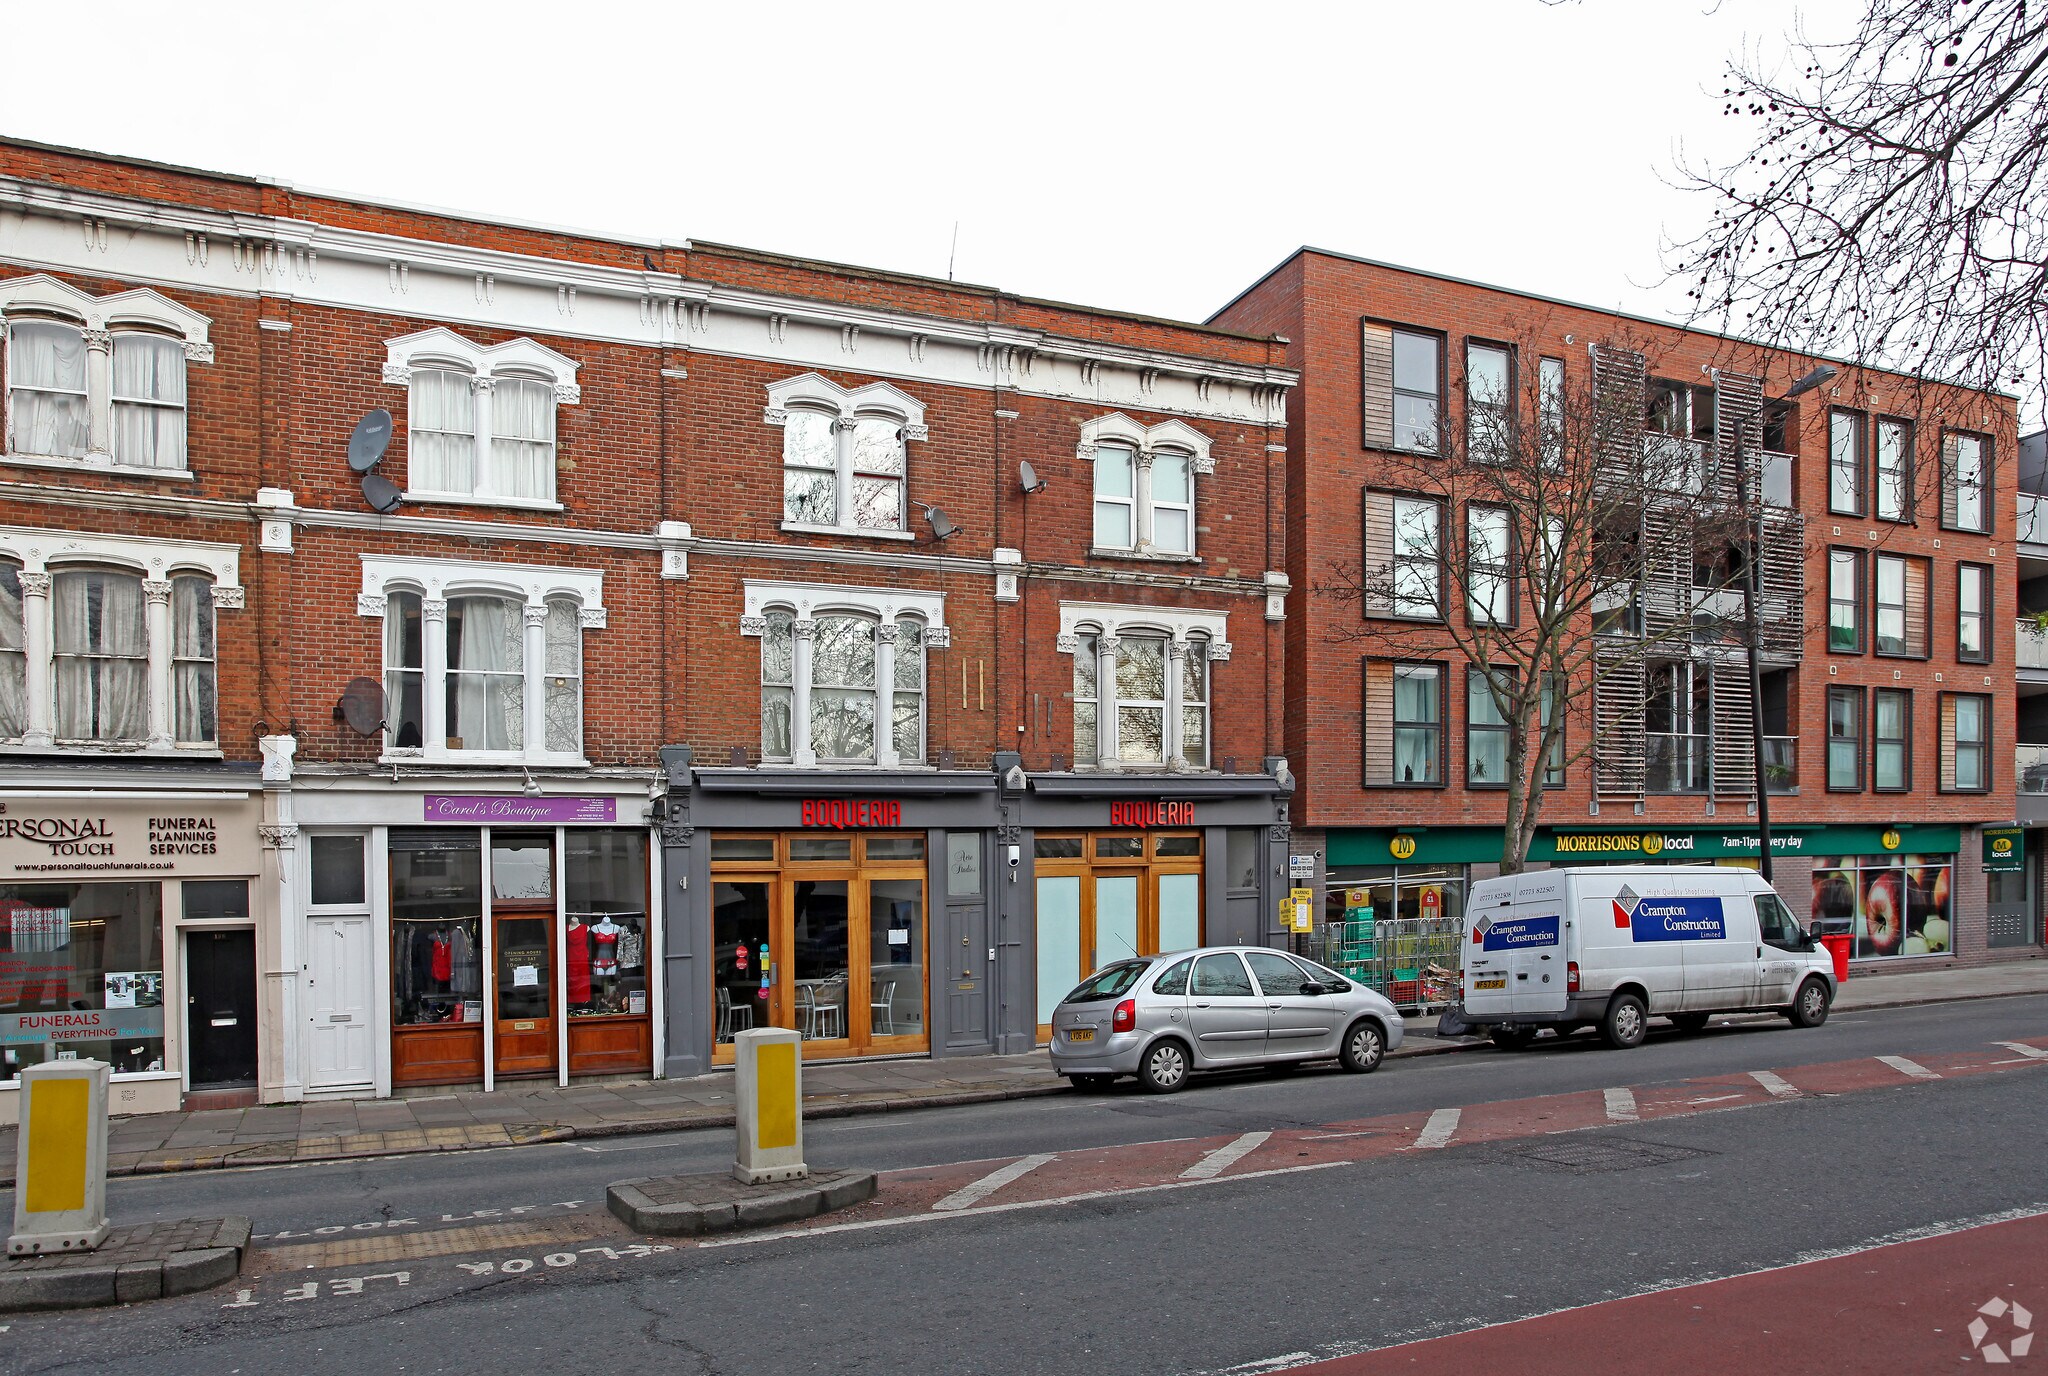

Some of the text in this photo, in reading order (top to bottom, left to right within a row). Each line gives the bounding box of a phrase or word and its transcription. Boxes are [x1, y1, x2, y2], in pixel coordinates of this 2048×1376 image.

[436, 797, 552, 821] Carol's Boutique
[802, 799, 901, 829] BOQUERIA
[1111, 801, 1195, 828] BOQUERIA
[148, 818, 216, 830] FUNERAL
[149, 831, 217, 842] PLANNING
[1984, 828, 2022, 836] MORRISONS
[48, 843, 115, 855] TOUCH
[150, 843, 217, 855] SERVICES
[1556, 835, 1640, 851] MORRISONS
[1664, 835, 1694, 850] local
[1768, 837, 1787, 849] very
[1787, 835, 1803, 849] day
[14, 861, 175, 872] www.personaltouchfunerals.co.uk
[1647, 887, 1716, 897] High Quality Shopfitting
[1639, 902, 1687, 918] Crampton
[1490, 925, 1526, 936] Crampton
[1663, 917, 1720, 931] Construction
[1506, 930, 1554, 943] Construction
[19, 1013, 101, 1029] FUNERALS
[51, 1028, 117, 1040] EVERYTHING
[119, 1027, 136, 1037] For
[139, 1026, 157, 1036] You
[275, 1200, 585, 1239] LOOK LEFT
[221, 1247, 620, 1309] LOOK LEFT
